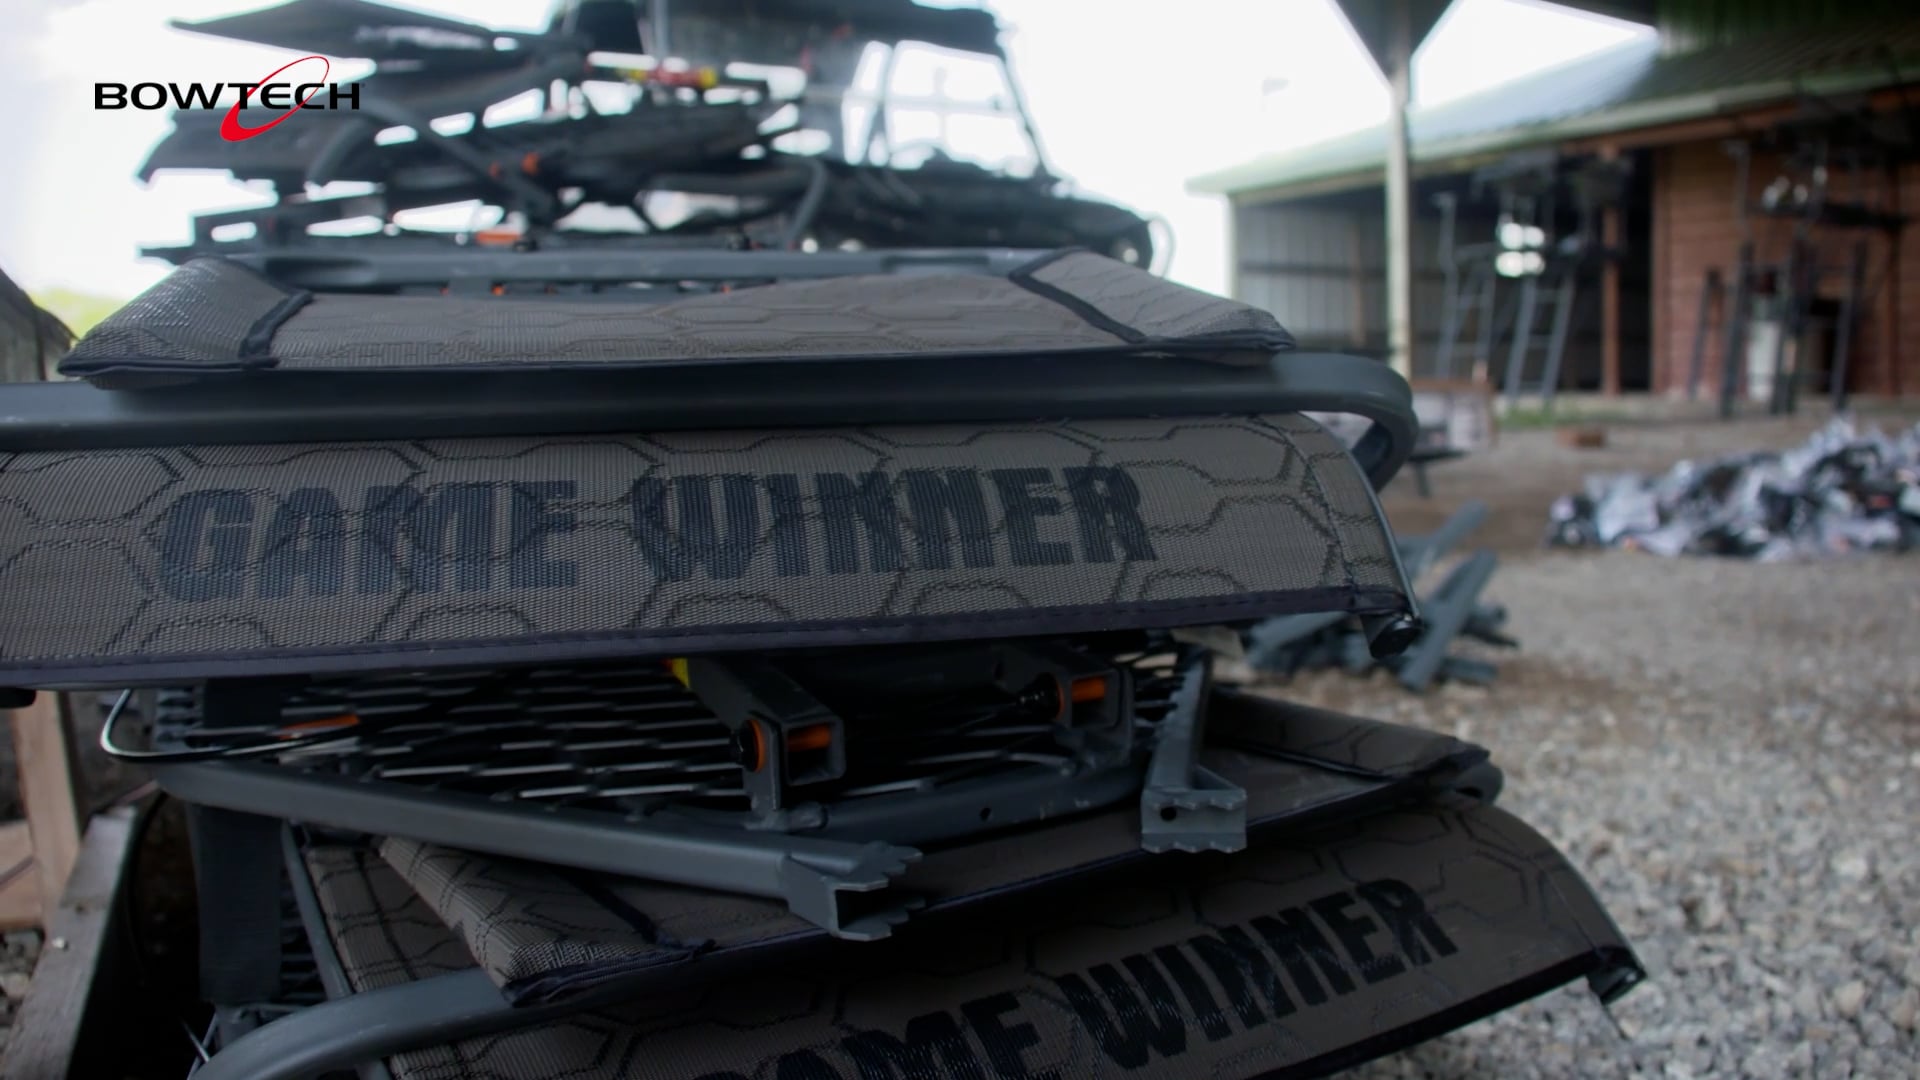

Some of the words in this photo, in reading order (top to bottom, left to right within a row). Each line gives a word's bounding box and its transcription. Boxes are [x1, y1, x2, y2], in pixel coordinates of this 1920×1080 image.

[160, 479, 577, 601] GAME
[632, 466, 1158, 582] WINNER
[692, 992, 1062, 1080] ME
[1055, 876, 1459, 1071] WINNER
